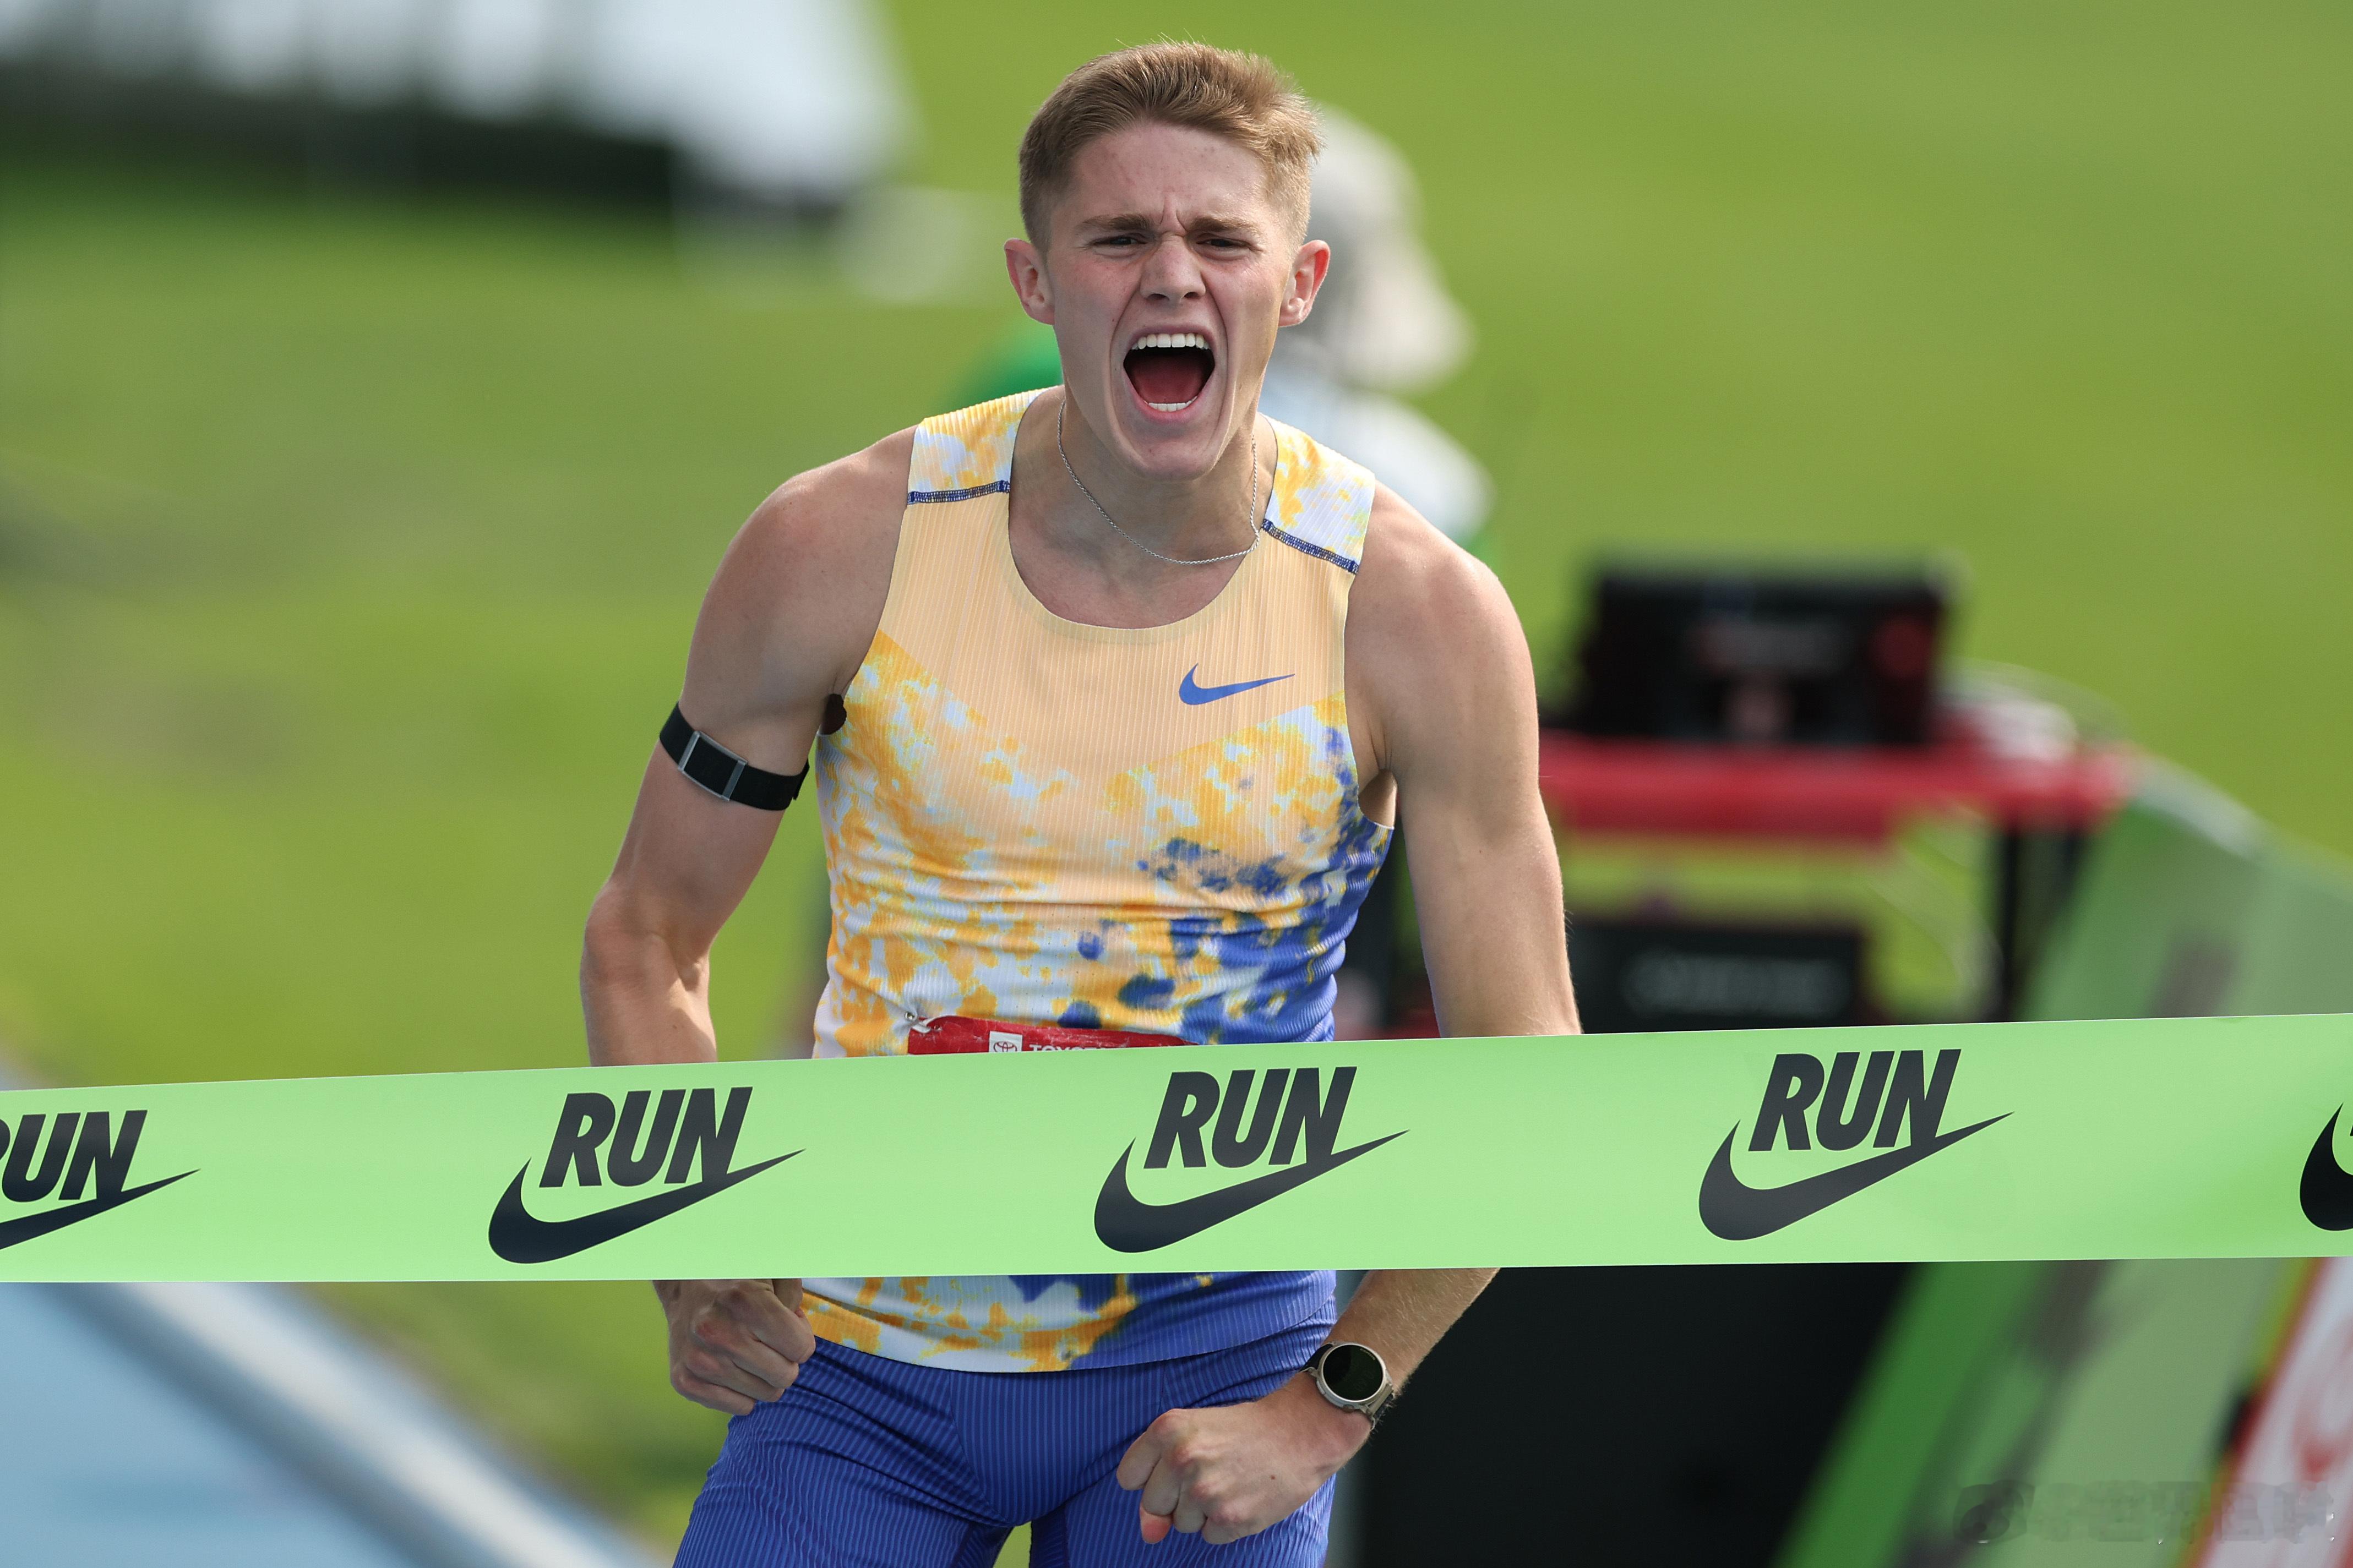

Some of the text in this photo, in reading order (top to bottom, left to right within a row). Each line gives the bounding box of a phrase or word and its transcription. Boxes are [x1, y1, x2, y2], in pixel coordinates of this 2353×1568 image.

[539, 1086, 753, 1188] RUN
[1143, 1066, 1358, 1169] RUN
[1748, 1048, 1962, 1152] RUN
[0, 1110, 148, 1202] UN
